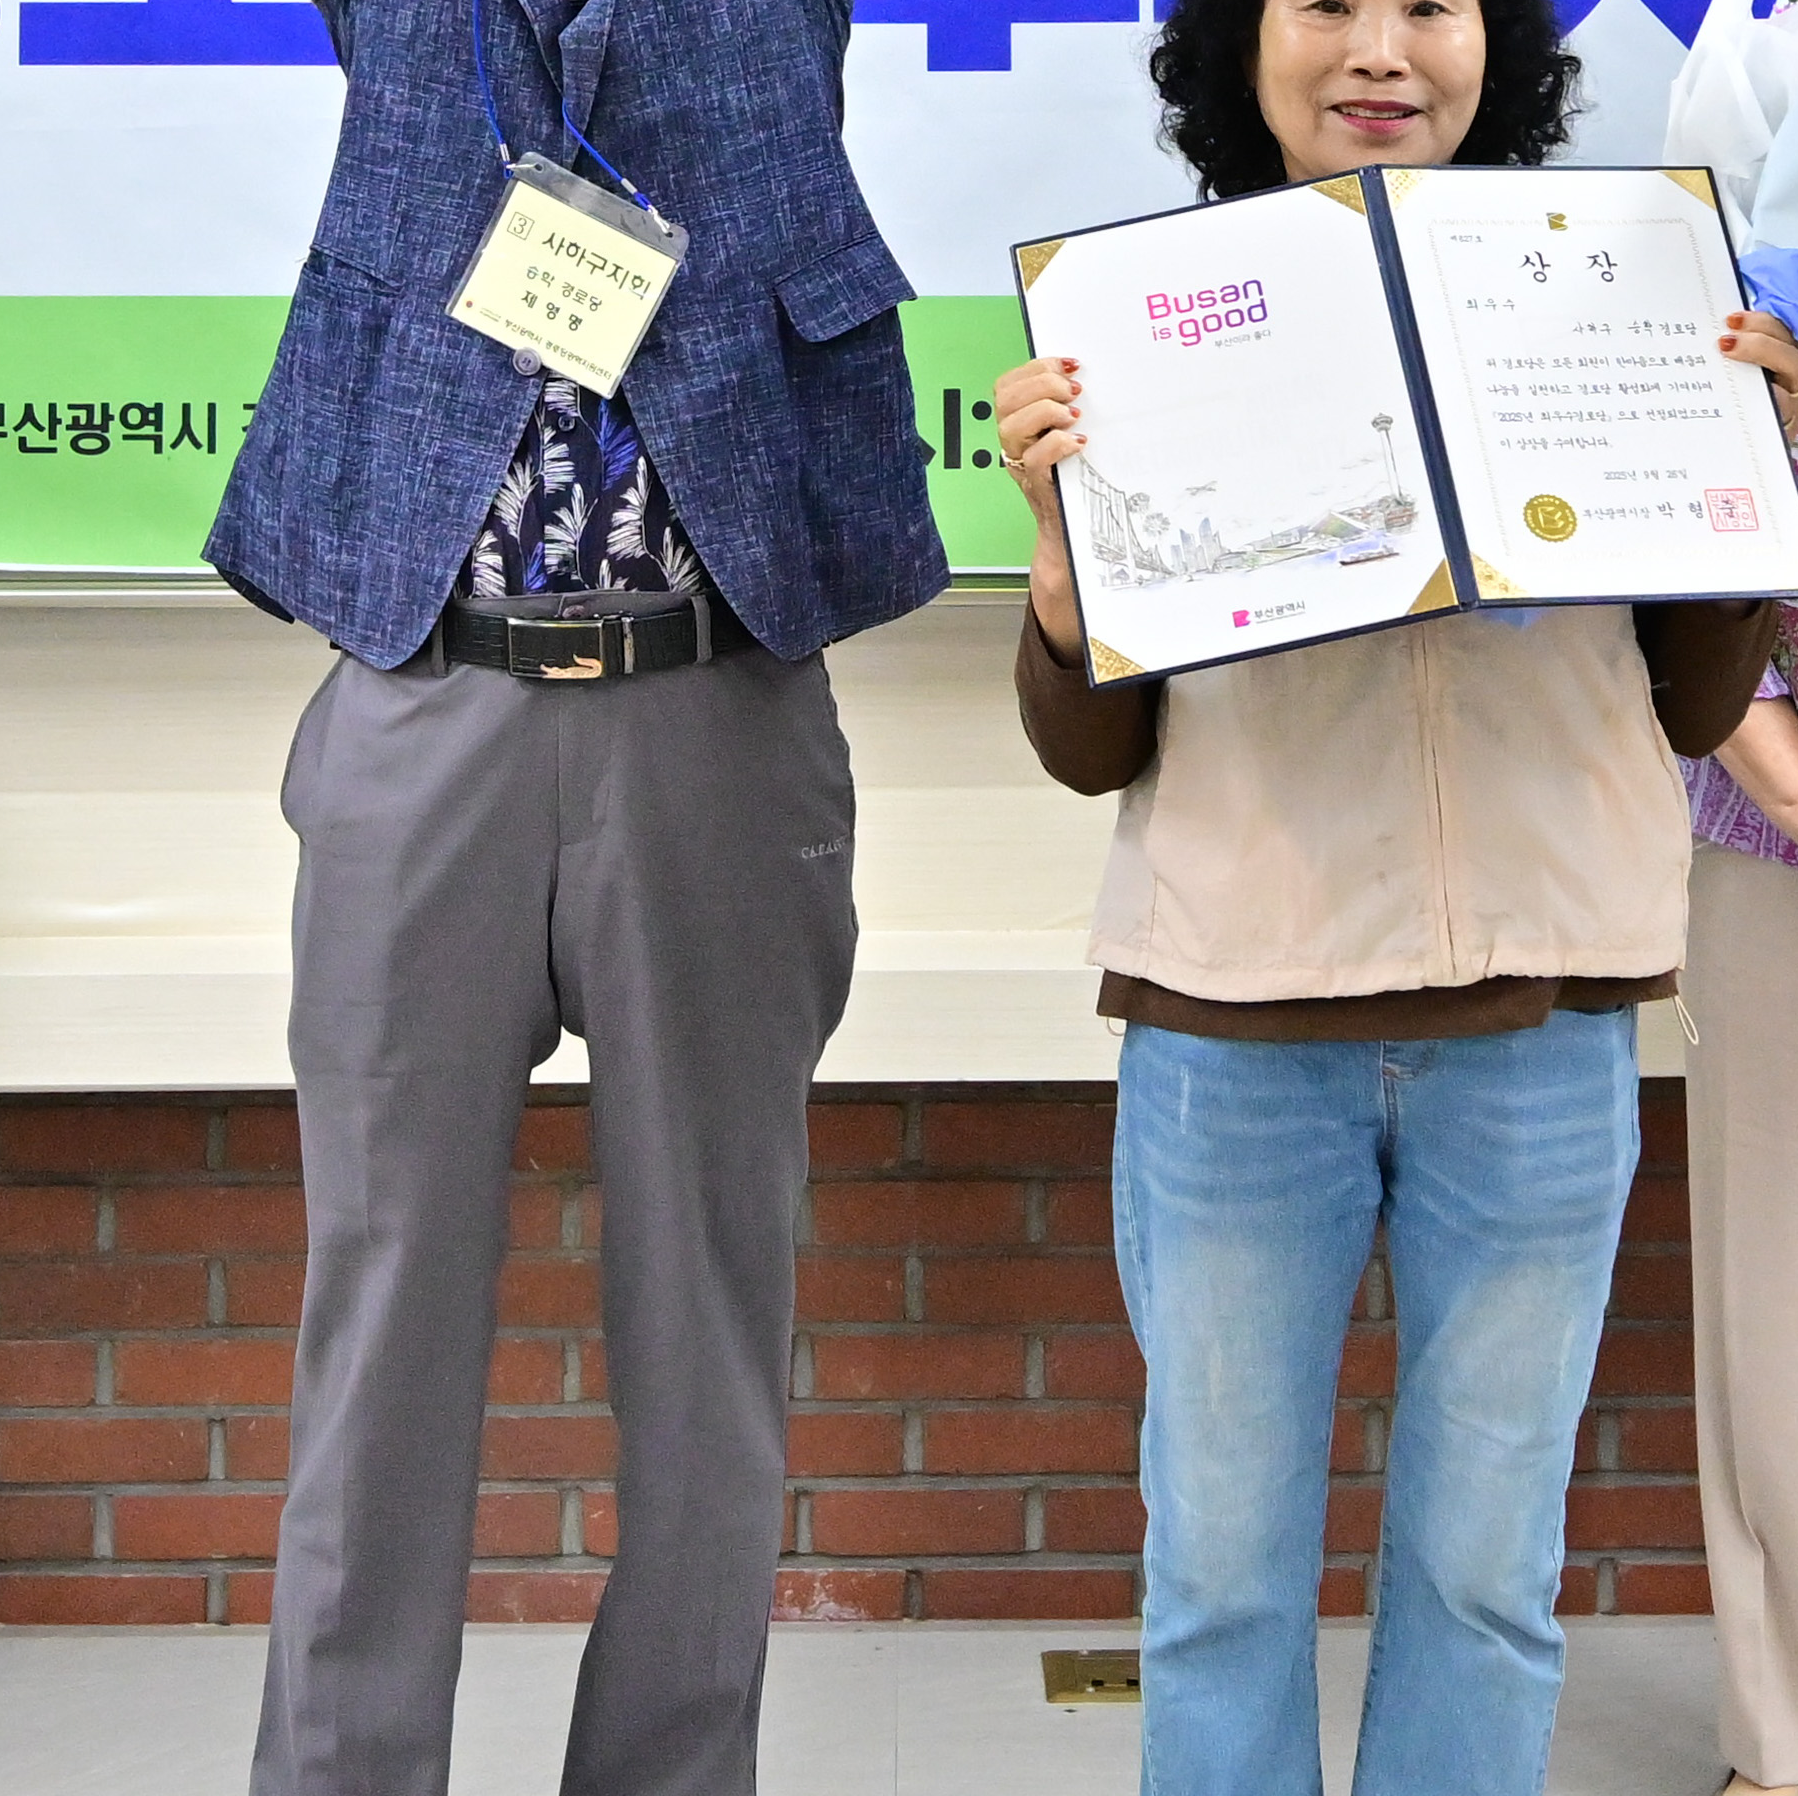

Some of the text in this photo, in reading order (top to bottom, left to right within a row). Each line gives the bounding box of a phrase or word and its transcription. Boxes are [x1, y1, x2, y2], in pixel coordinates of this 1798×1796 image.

[513, 217, 652, 301] 3 사하구지회
[1518, 250, 1618, 283] 상 장
[561, 281, 603, 312] 경로당
[1146, 279, 1264, 320] Busan
[1151, 297, 1268, 347] is good
[1603, 469, 1637, 481] 2025년
[1582, 506, 1651, 522] 부산광역시장
[1657, 500, 1675, 519] 박
[1254, 600, 1306, 619] 부산광역시
